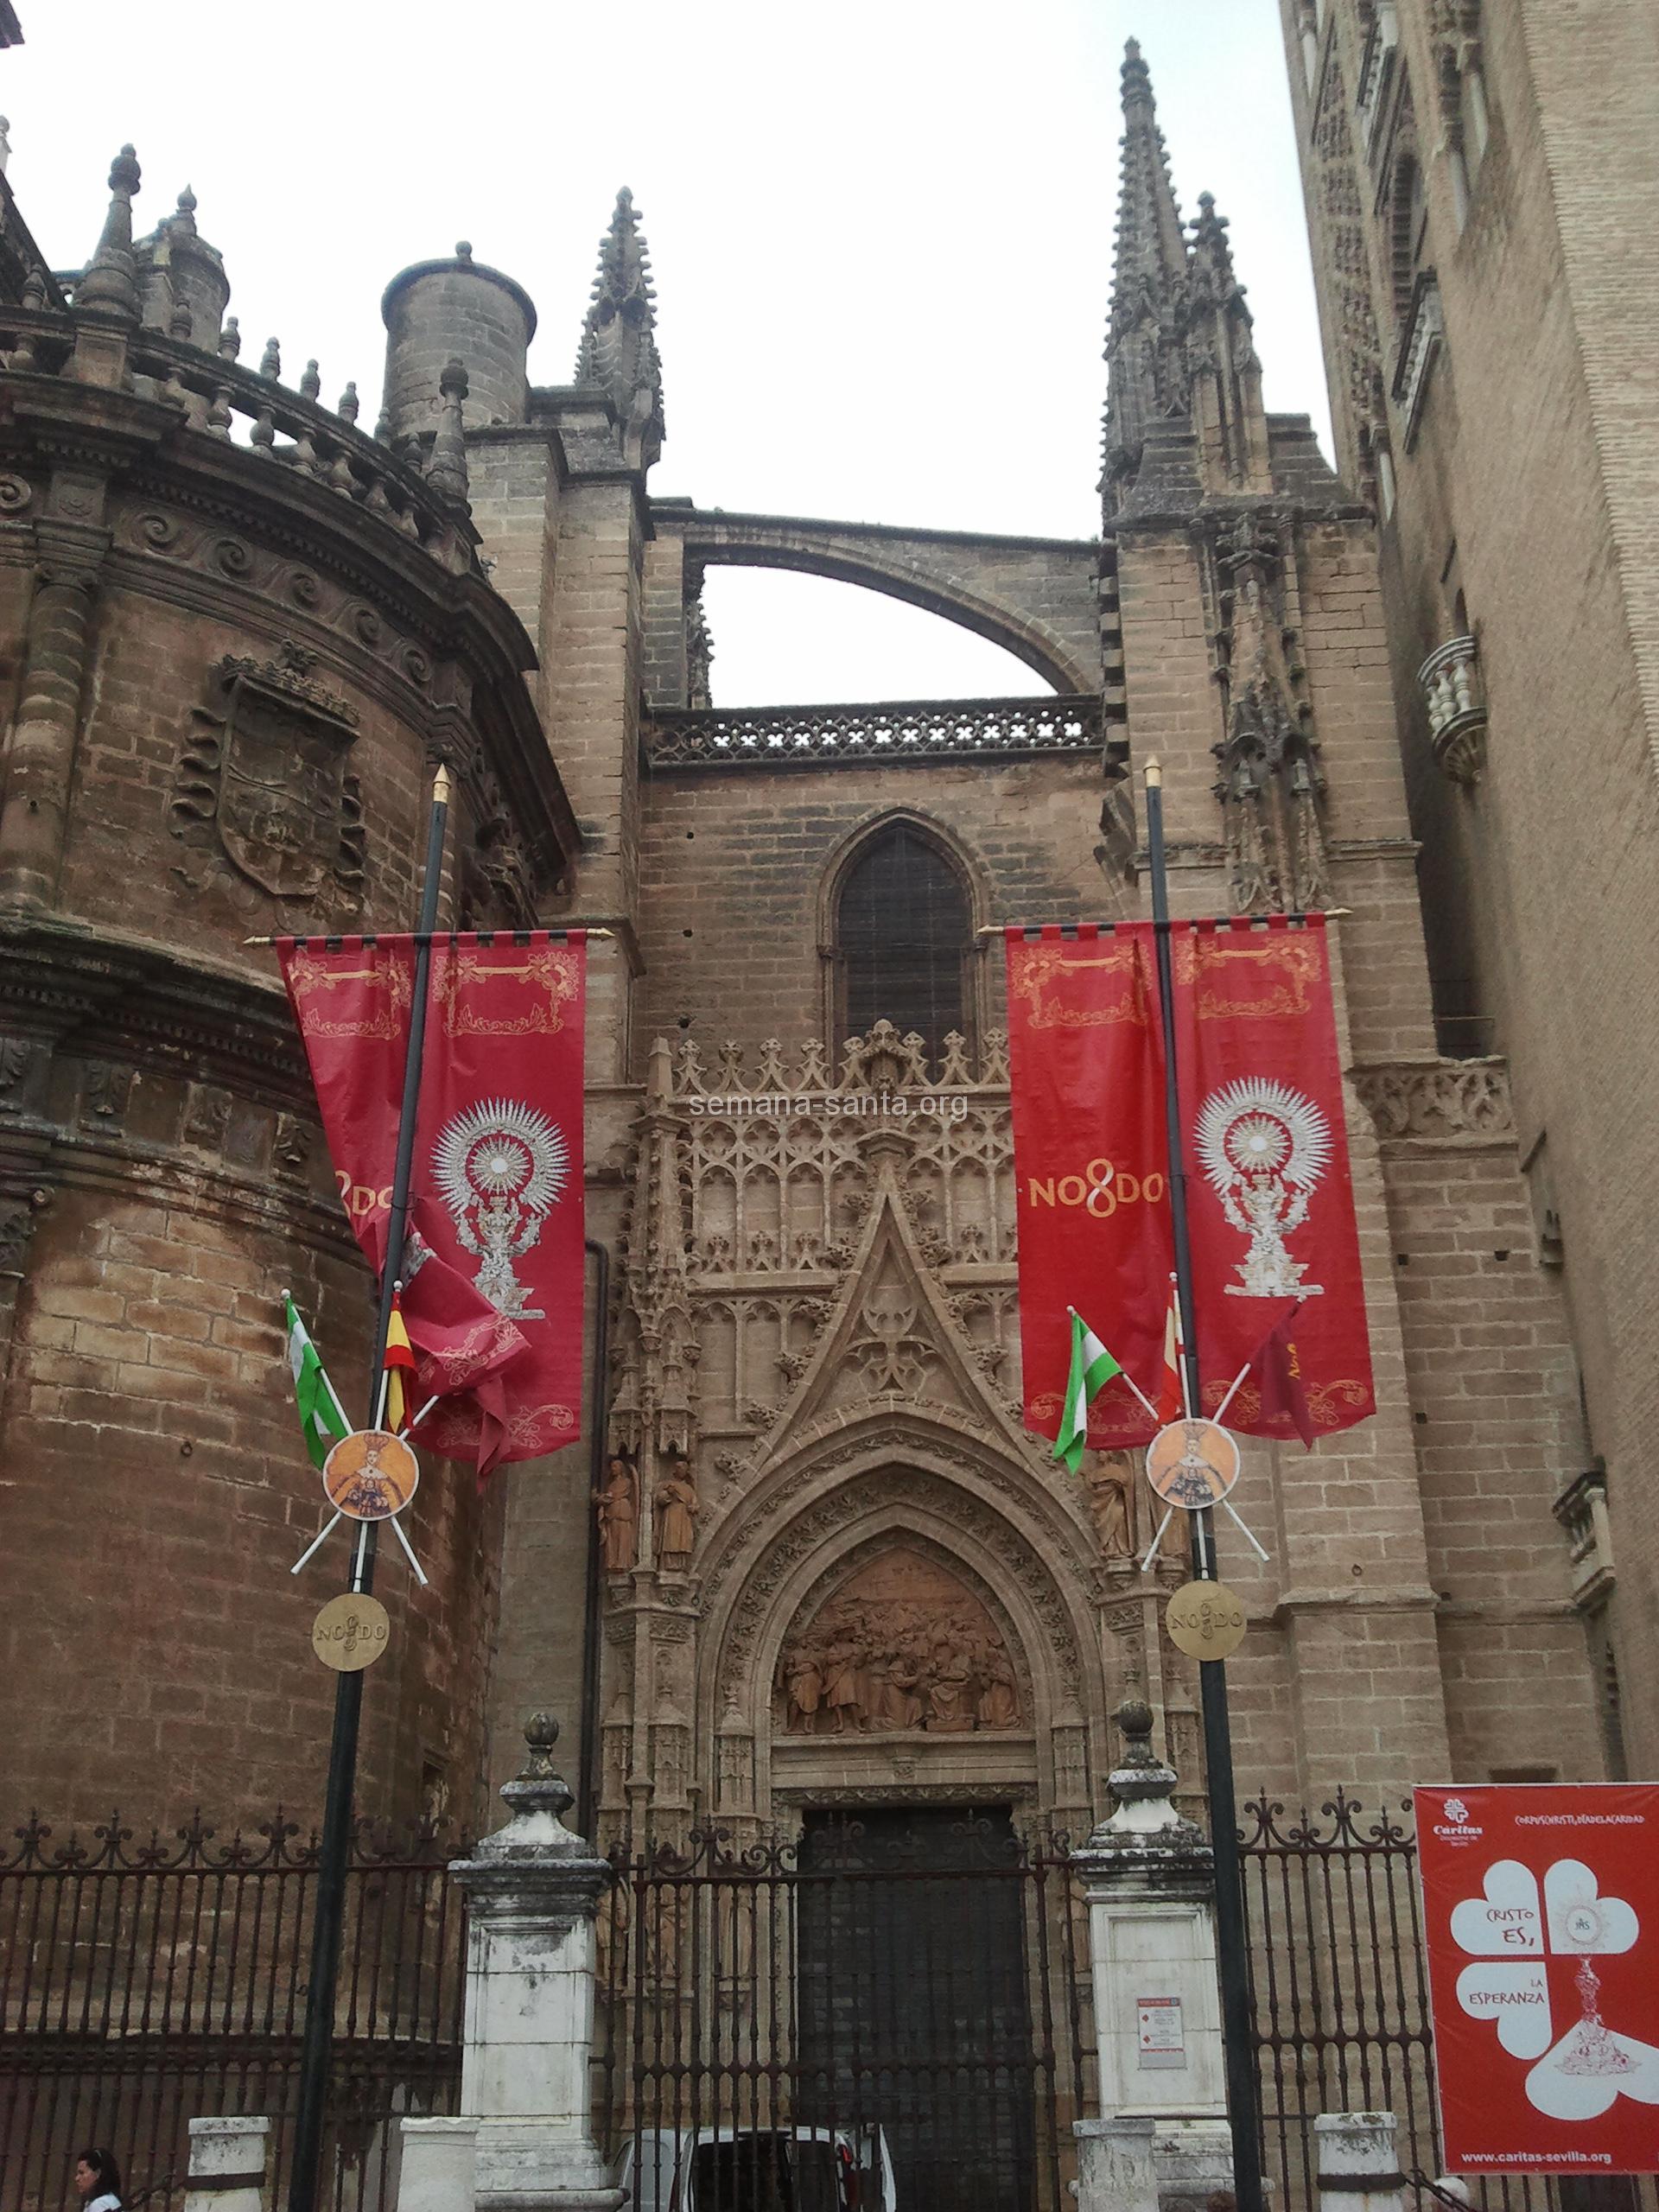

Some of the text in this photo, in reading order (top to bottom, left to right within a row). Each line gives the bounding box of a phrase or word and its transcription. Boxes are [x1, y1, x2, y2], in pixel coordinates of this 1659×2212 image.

[1027, 1159, 1164, 1218] NO8DO
[1486, 1909, 1535, 1923] CRISTO
[1502, 1926, 1535, 1947] ES,
[1530, 1979, 1543, 1987] LA
[1469, 1992, 1546, 2005] ESPERANZA
[1461, 2151, 1612, 2164] www.caritas-sevilla.org
